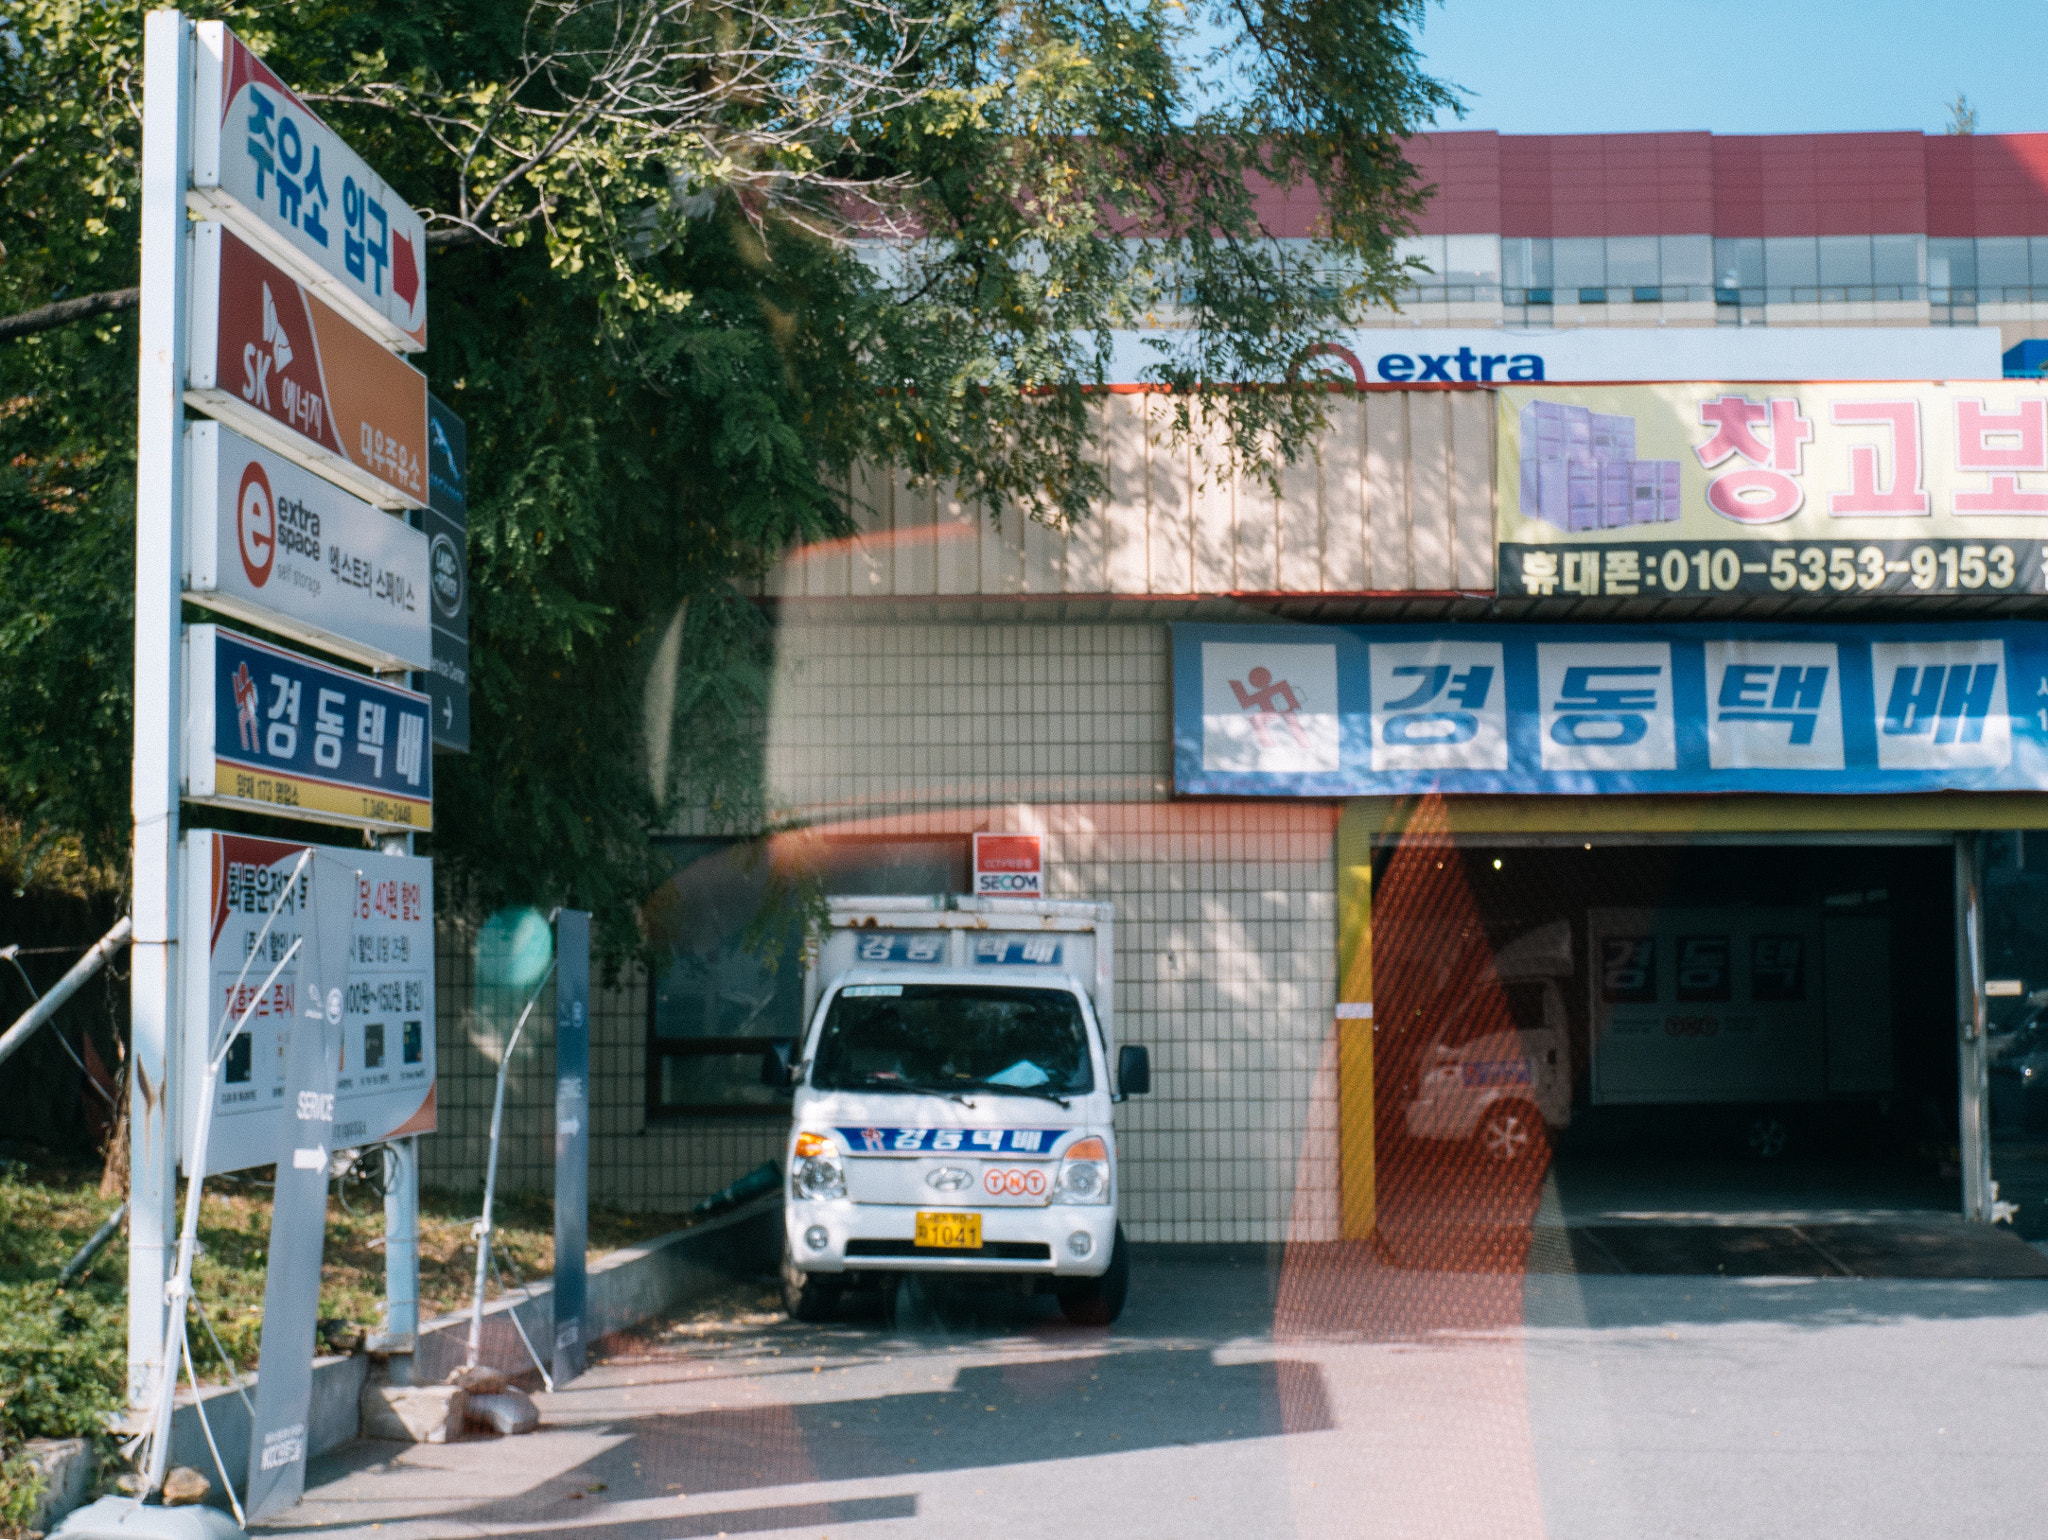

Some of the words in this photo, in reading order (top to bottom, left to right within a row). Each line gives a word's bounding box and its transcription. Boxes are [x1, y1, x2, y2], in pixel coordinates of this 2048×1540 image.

[247, 83, 329, 248] 주유소
[343, 176, 388, 297] 입구
[1377, 347, 1546, 382] extra
[242, 342, 272, 412] SK
[281, 376, 323, 440] 에너지
[277, 496, 320, 537] extra
[277, 525, 320, 562] space
[329, 546, 374, 598] 엑스트라
[375, 568, 415, 612] 스페이스
[1522, 546, 2015, 595] 휴대폰:010-5353-9153
[1383, 664, 1999, 746] 경동택배
[265, 673, 424, 786] 경동택배
[980, 875, 1038, 891] SECOM
[897, 1128, 1044, 1151] 경동택배
[987, 1172, 1044, 1193] TNT
